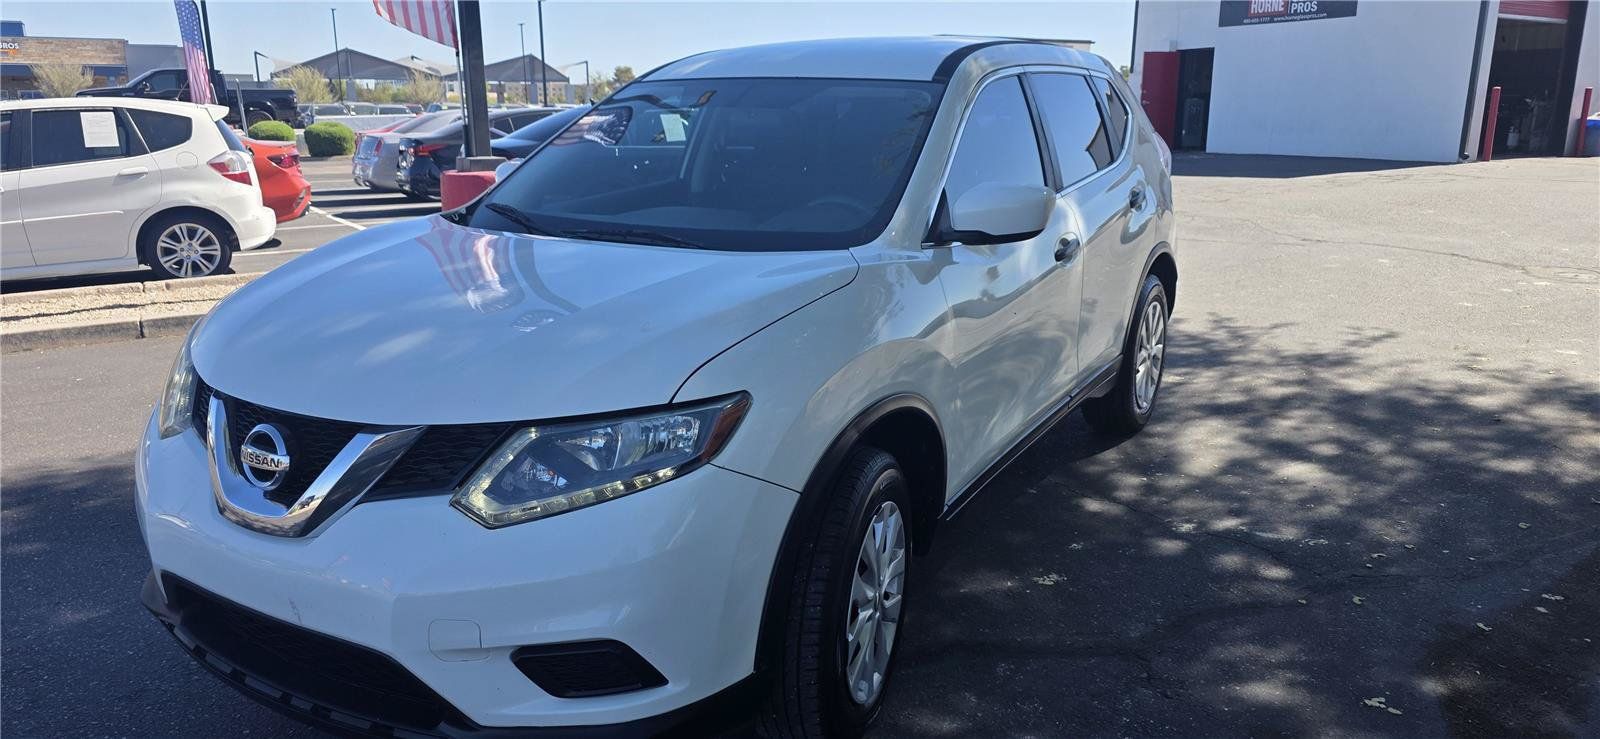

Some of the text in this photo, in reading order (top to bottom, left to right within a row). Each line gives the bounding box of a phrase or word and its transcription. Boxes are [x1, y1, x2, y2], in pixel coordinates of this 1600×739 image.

[1250, 0, 1285, 14] HORNE
[1291, 1, 1318, 13] PROS
[241, 450, 280, 468] NISSAN
